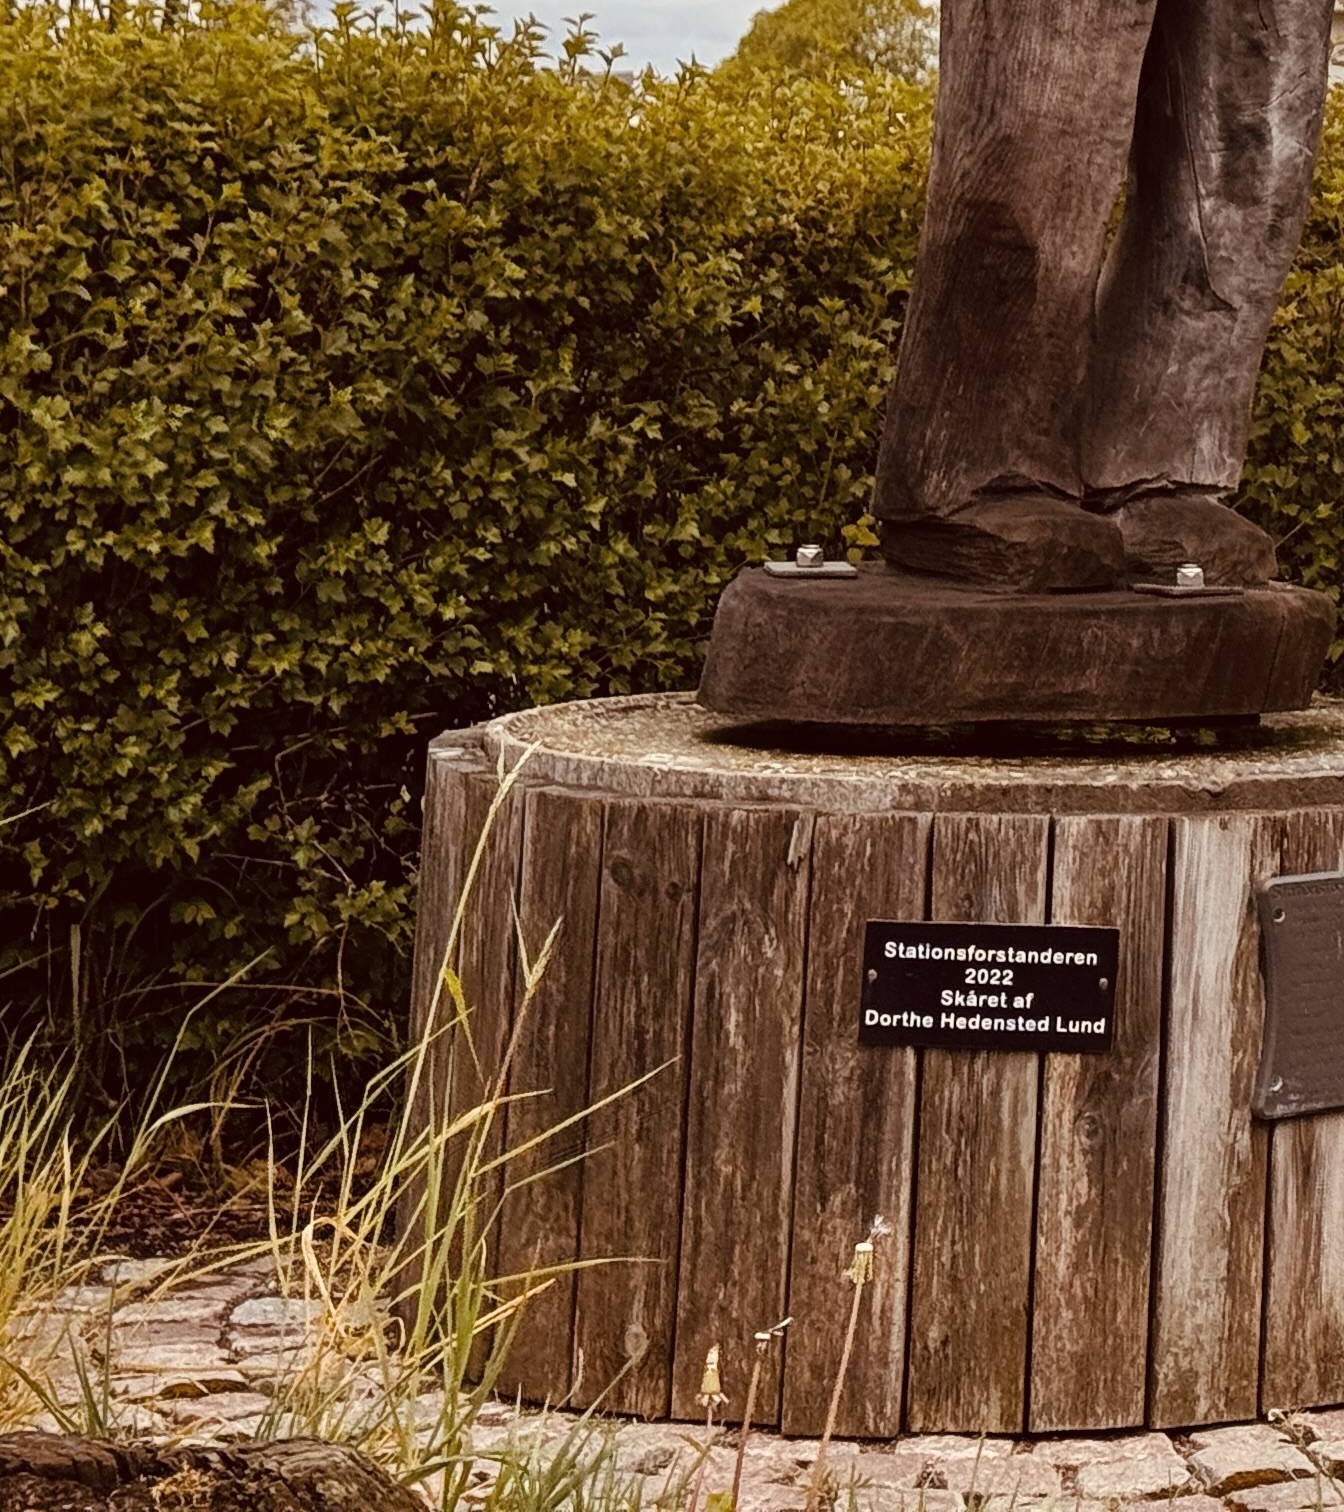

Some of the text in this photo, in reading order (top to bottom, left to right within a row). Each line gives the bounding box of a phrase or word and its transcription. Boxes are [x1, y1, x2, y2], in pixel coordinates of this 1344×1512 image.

[884, 941, 1098, 966] Stationsforstanderen
[964, 968, 1014, 986] 2022
[940, 989, 1035, 1009] Skåret af
[864, 1008, 1106, 1034] Dorthe Hedensted Lund
